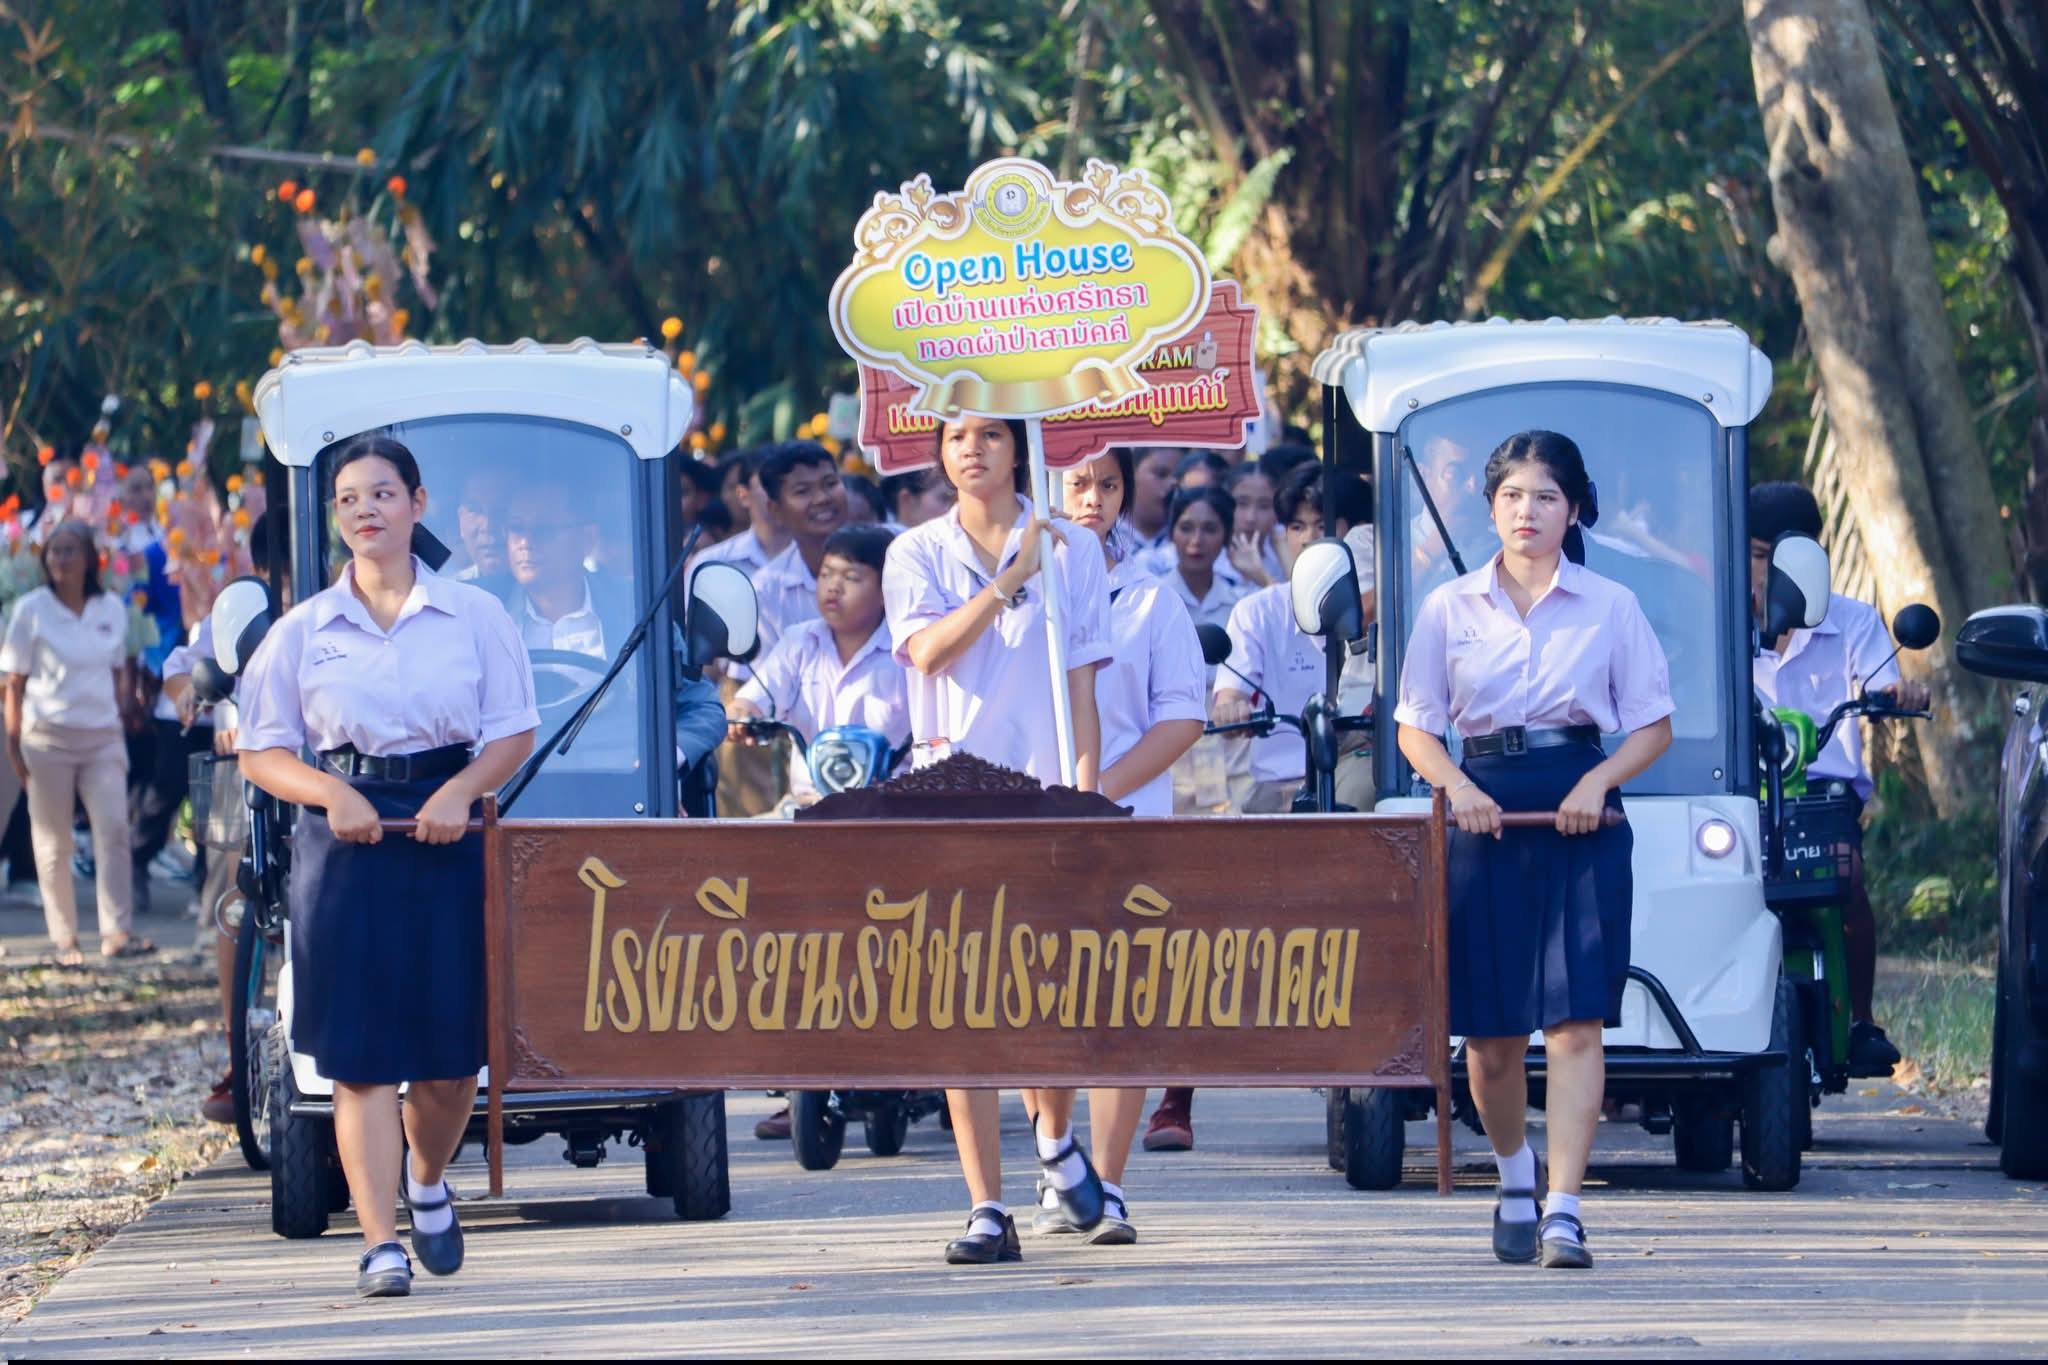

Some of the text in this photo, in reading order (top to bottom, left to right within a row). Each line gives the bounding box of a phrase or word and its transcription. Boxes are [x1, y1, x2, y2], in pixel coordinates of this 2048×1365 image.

[902, 240, 1133, 296] Open House
[894, 282, 1148, 329] เปิดบ้านแห่งศรัทธา
[917, 314, 1130, 361] ทอดผ้าป่าสามัคคี
[1138, 344, 1194, 370] RAM
[1784, 844, 1820, 861] บาย
[577, 856, 1360, 1033] โรงเรียนรัชชประภาวิทยาคม
